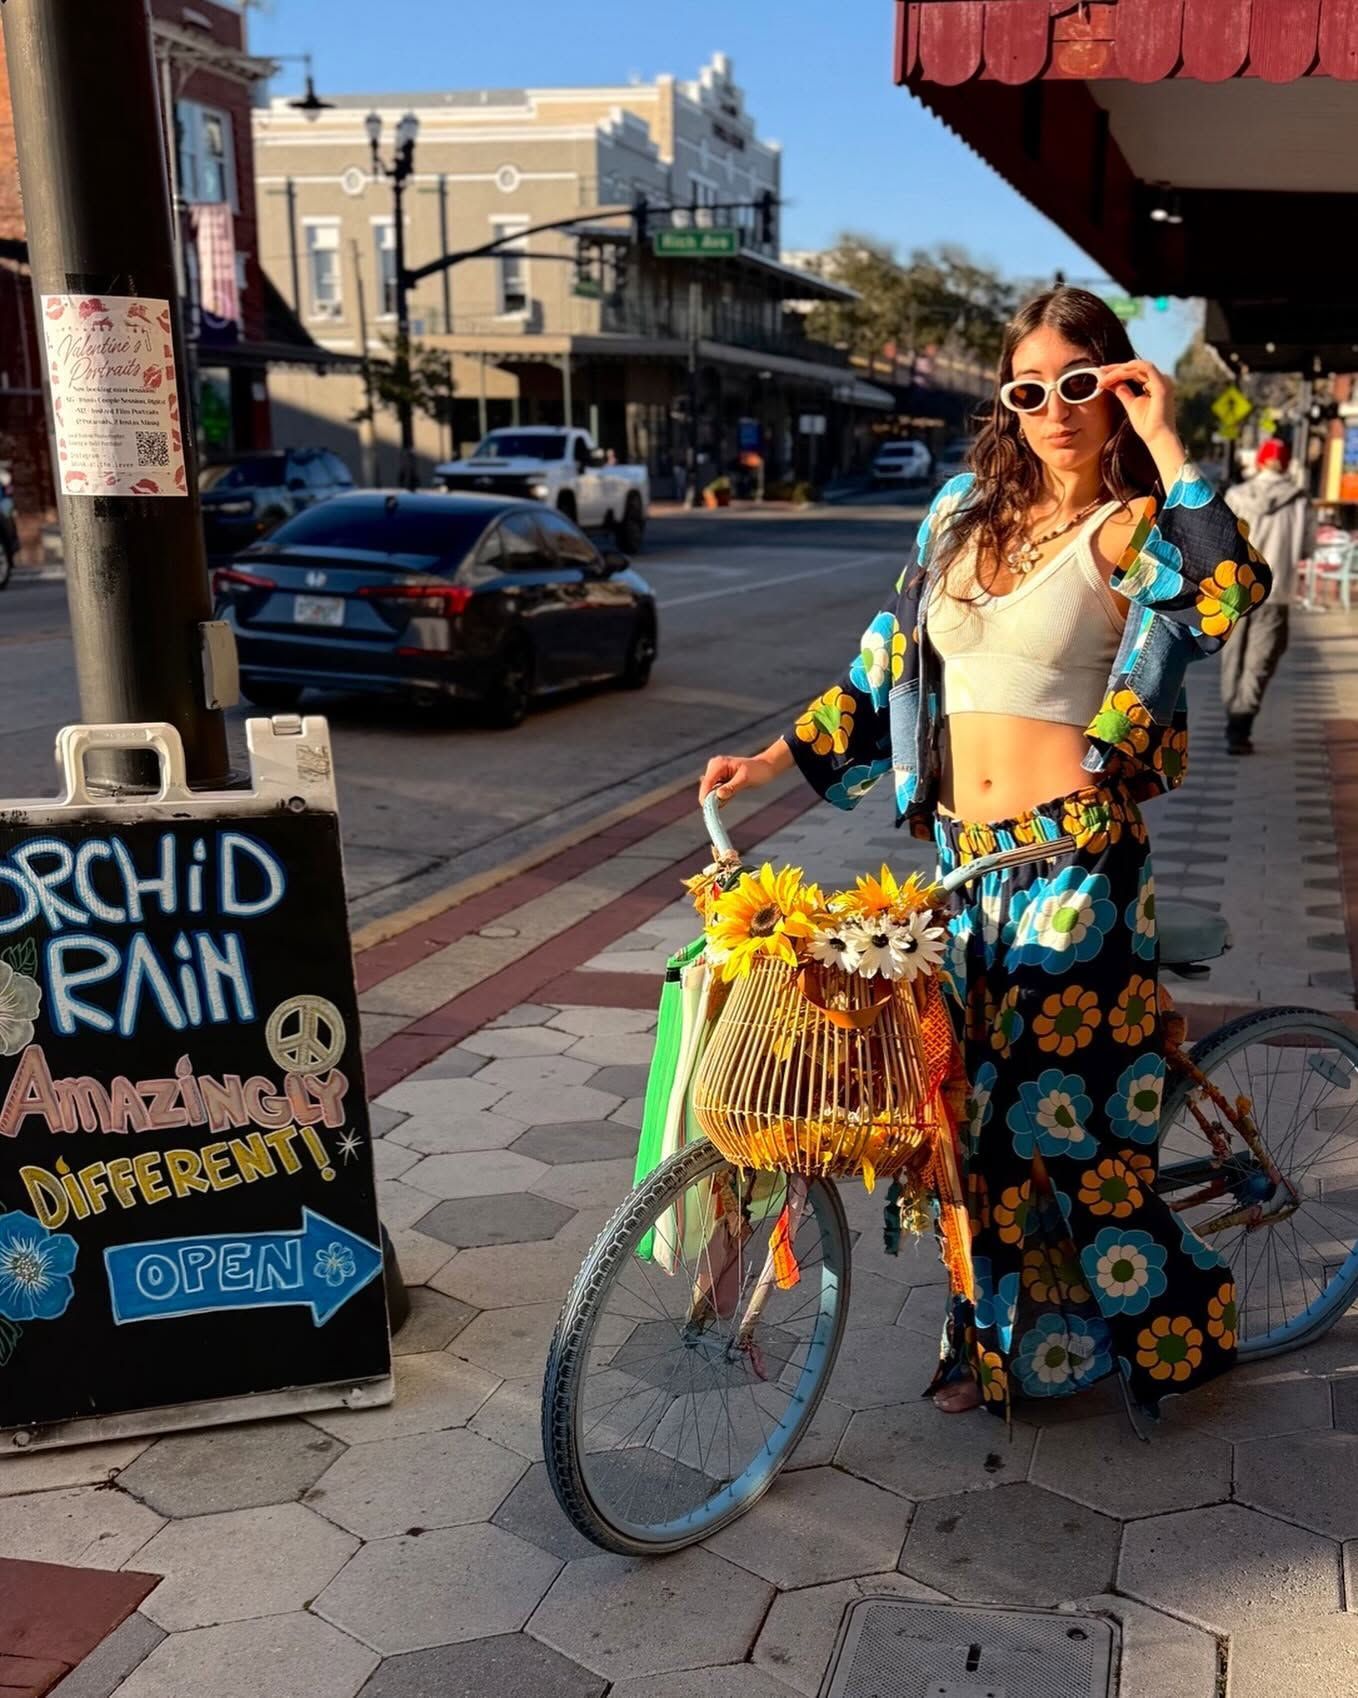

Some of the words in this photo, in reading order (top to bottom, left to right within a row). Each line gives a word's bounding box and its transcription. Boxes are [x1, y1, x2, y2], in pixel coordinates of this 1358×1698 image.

[58, 334, 142, 365] Valentine's
[69, 356, 141, 388] Portraits
[98, 397, 120, 405] Couple
[136, 1239, 304, 1300] OPEN
